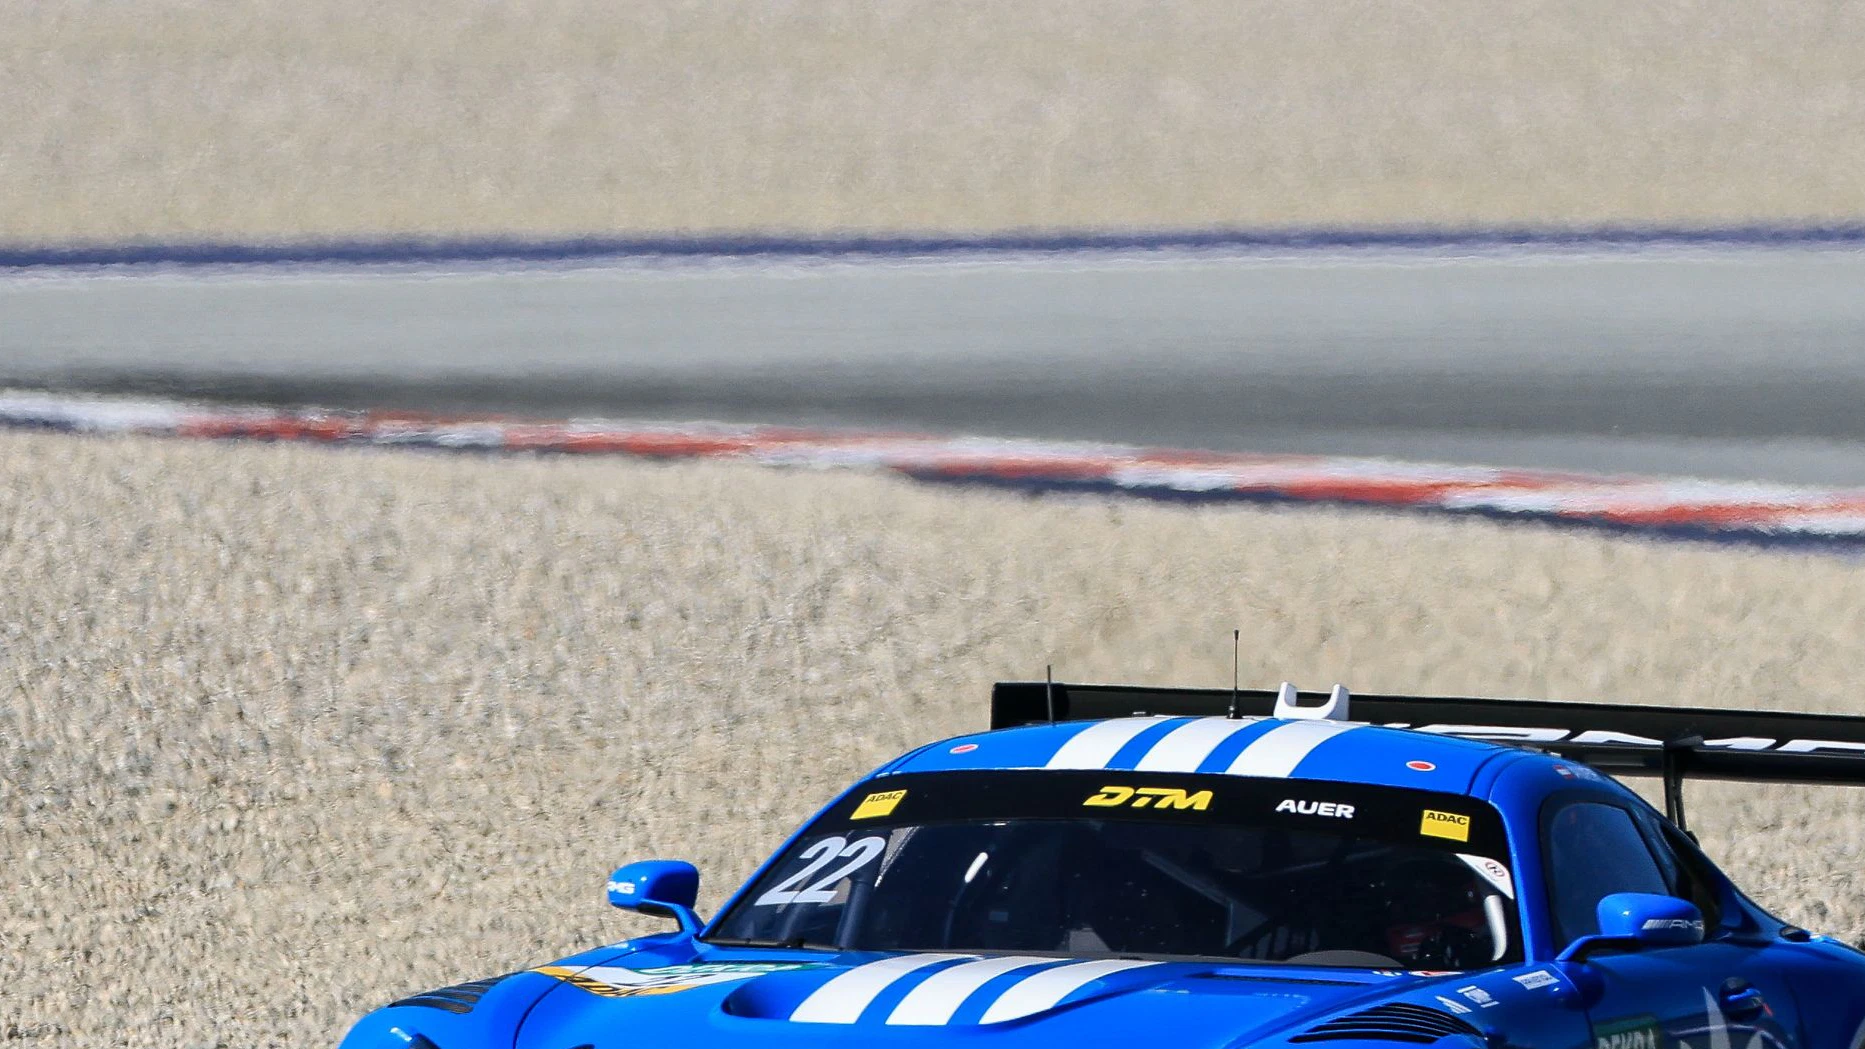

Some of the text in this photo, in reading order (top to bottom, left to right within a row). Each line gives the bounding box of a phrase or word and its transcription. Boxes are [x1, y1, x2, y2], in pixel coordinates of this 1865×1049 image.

[867, 791, 903, 803] ADAC
[1082, 785, 1213, 811] DTM
[1275, 799, 1355, 819] AUER
[1424, 811, 1468, 826] ADAC
[754, 836, 886, 906] 22
